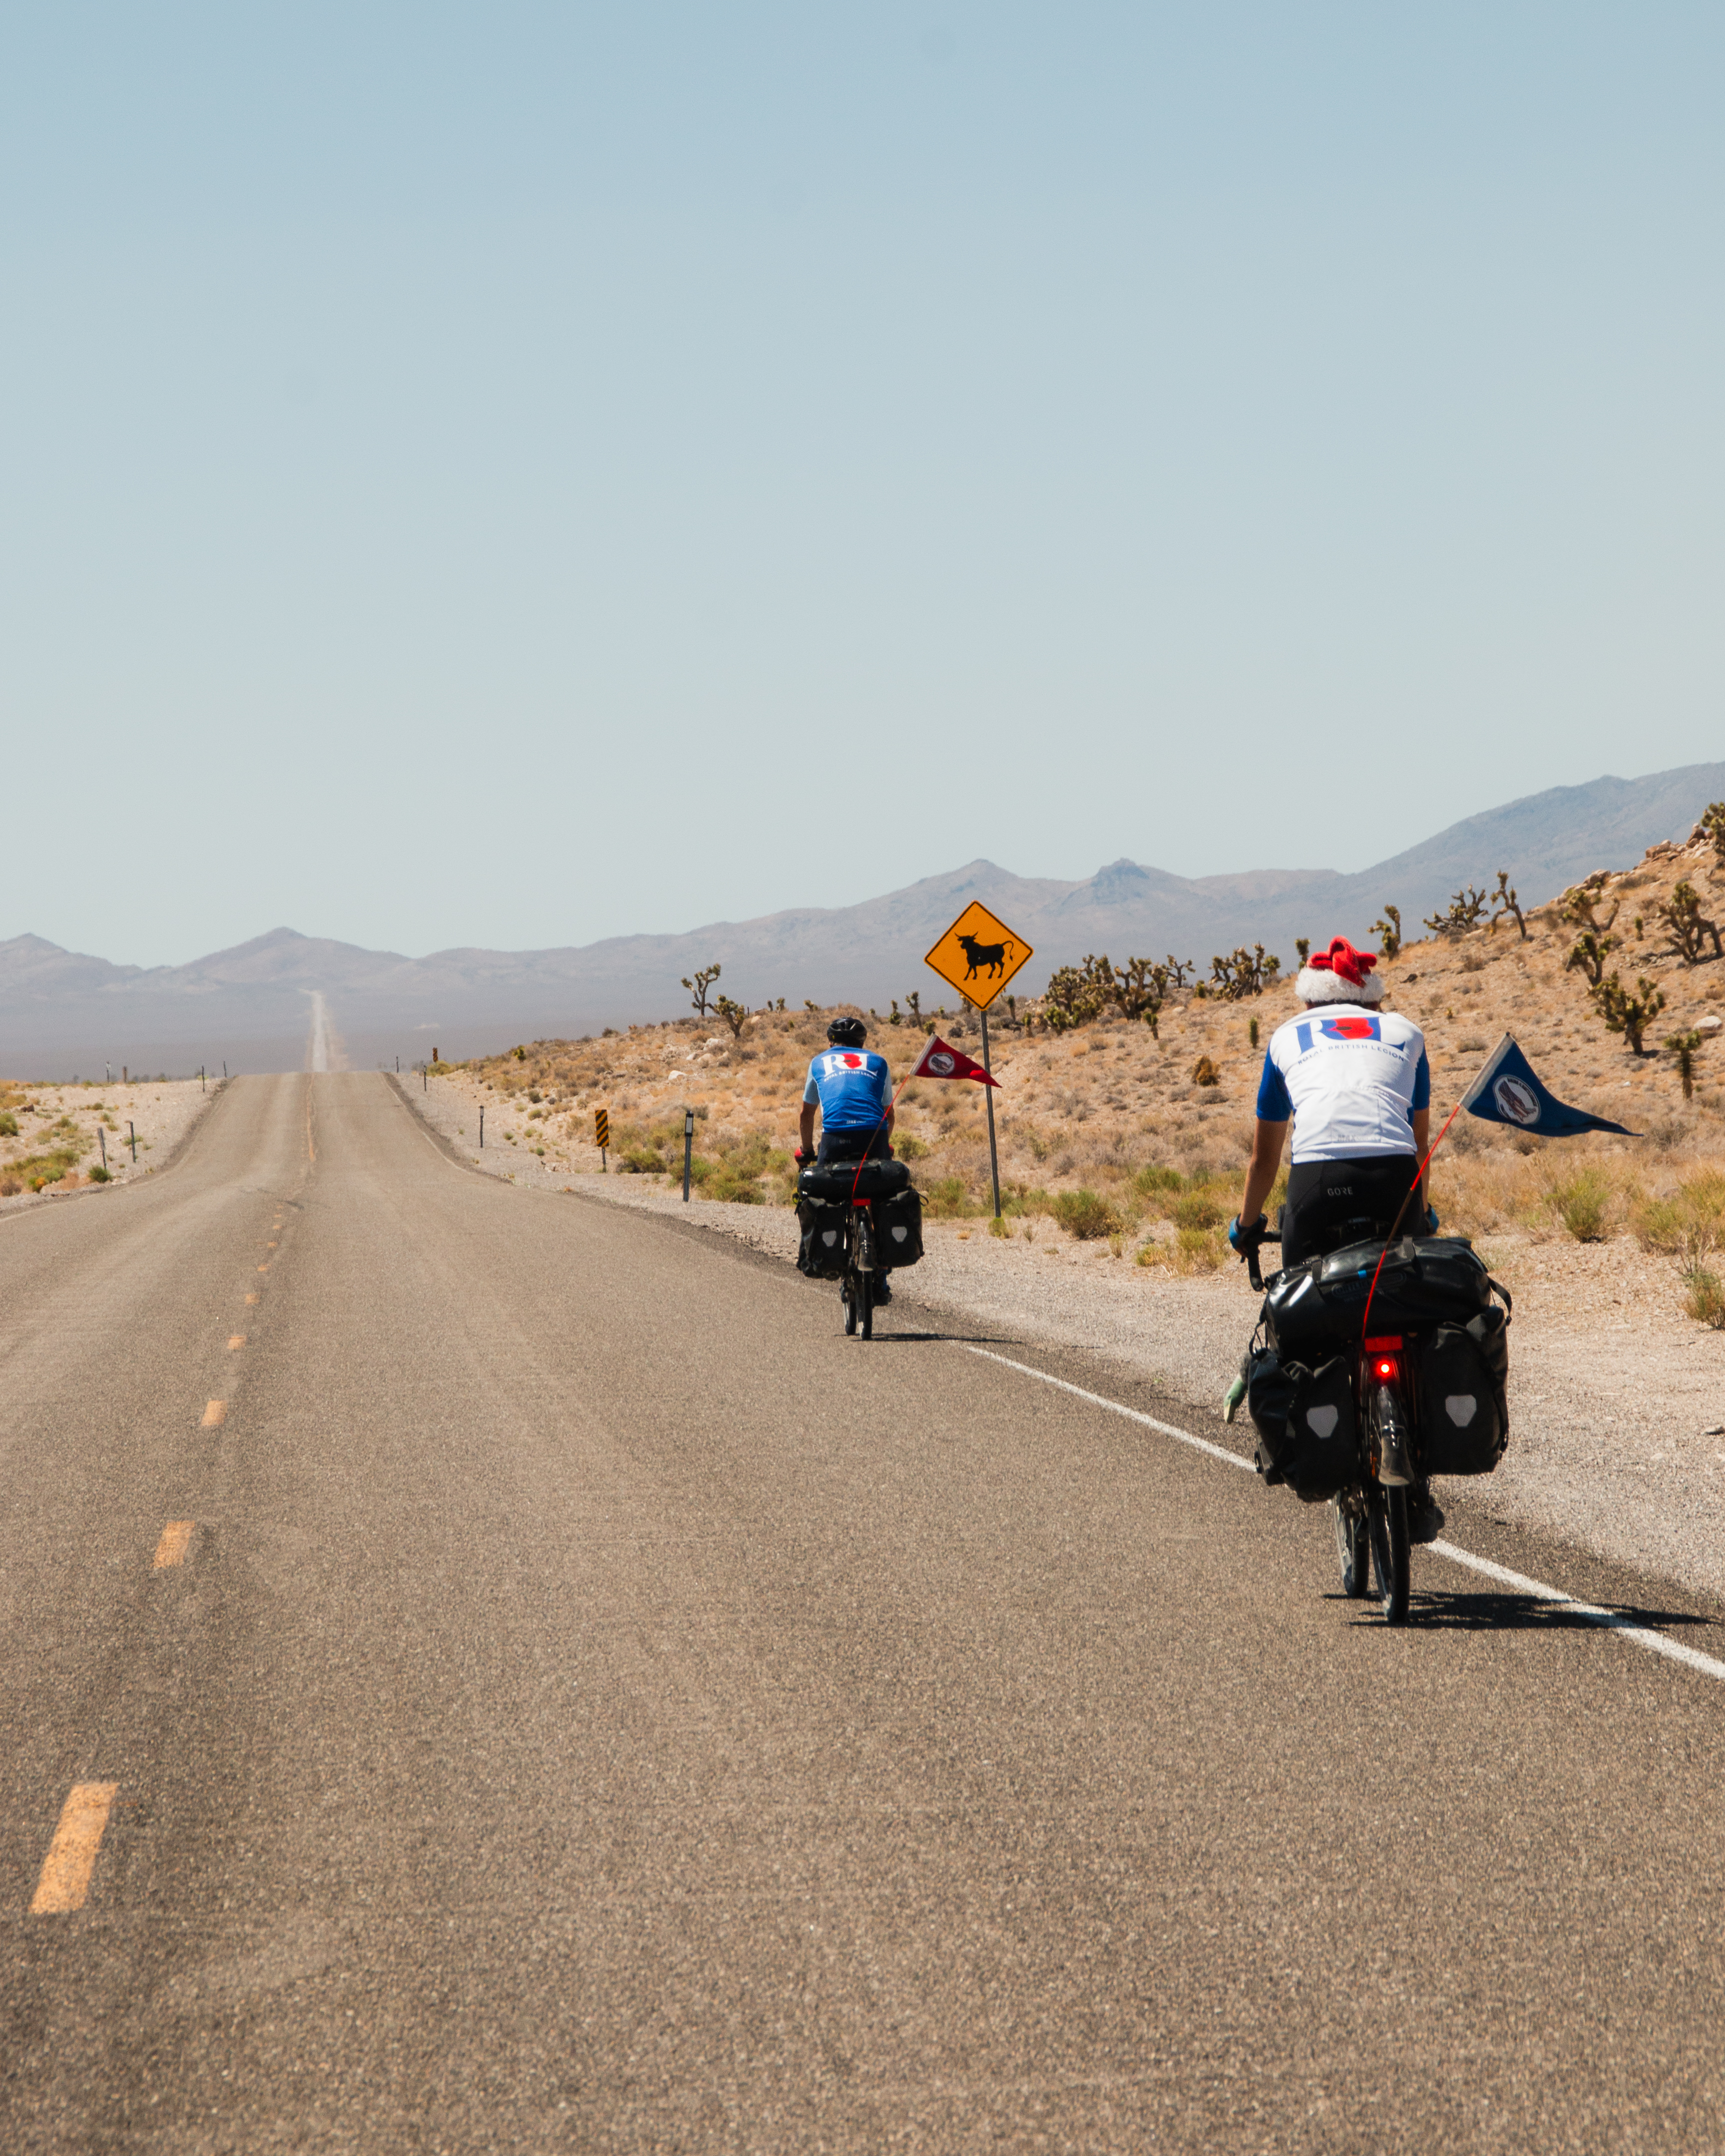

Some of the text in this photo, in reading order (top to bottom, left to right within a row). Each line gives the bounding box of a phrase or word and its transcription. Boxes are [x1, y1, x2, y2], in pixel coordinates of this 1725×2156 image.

[1298, 1049, 1324, 1065] ROYAL
[1371, 1045, 1405, 1062] LEGION
[1327, 1186, 1354, 1196] GORE
